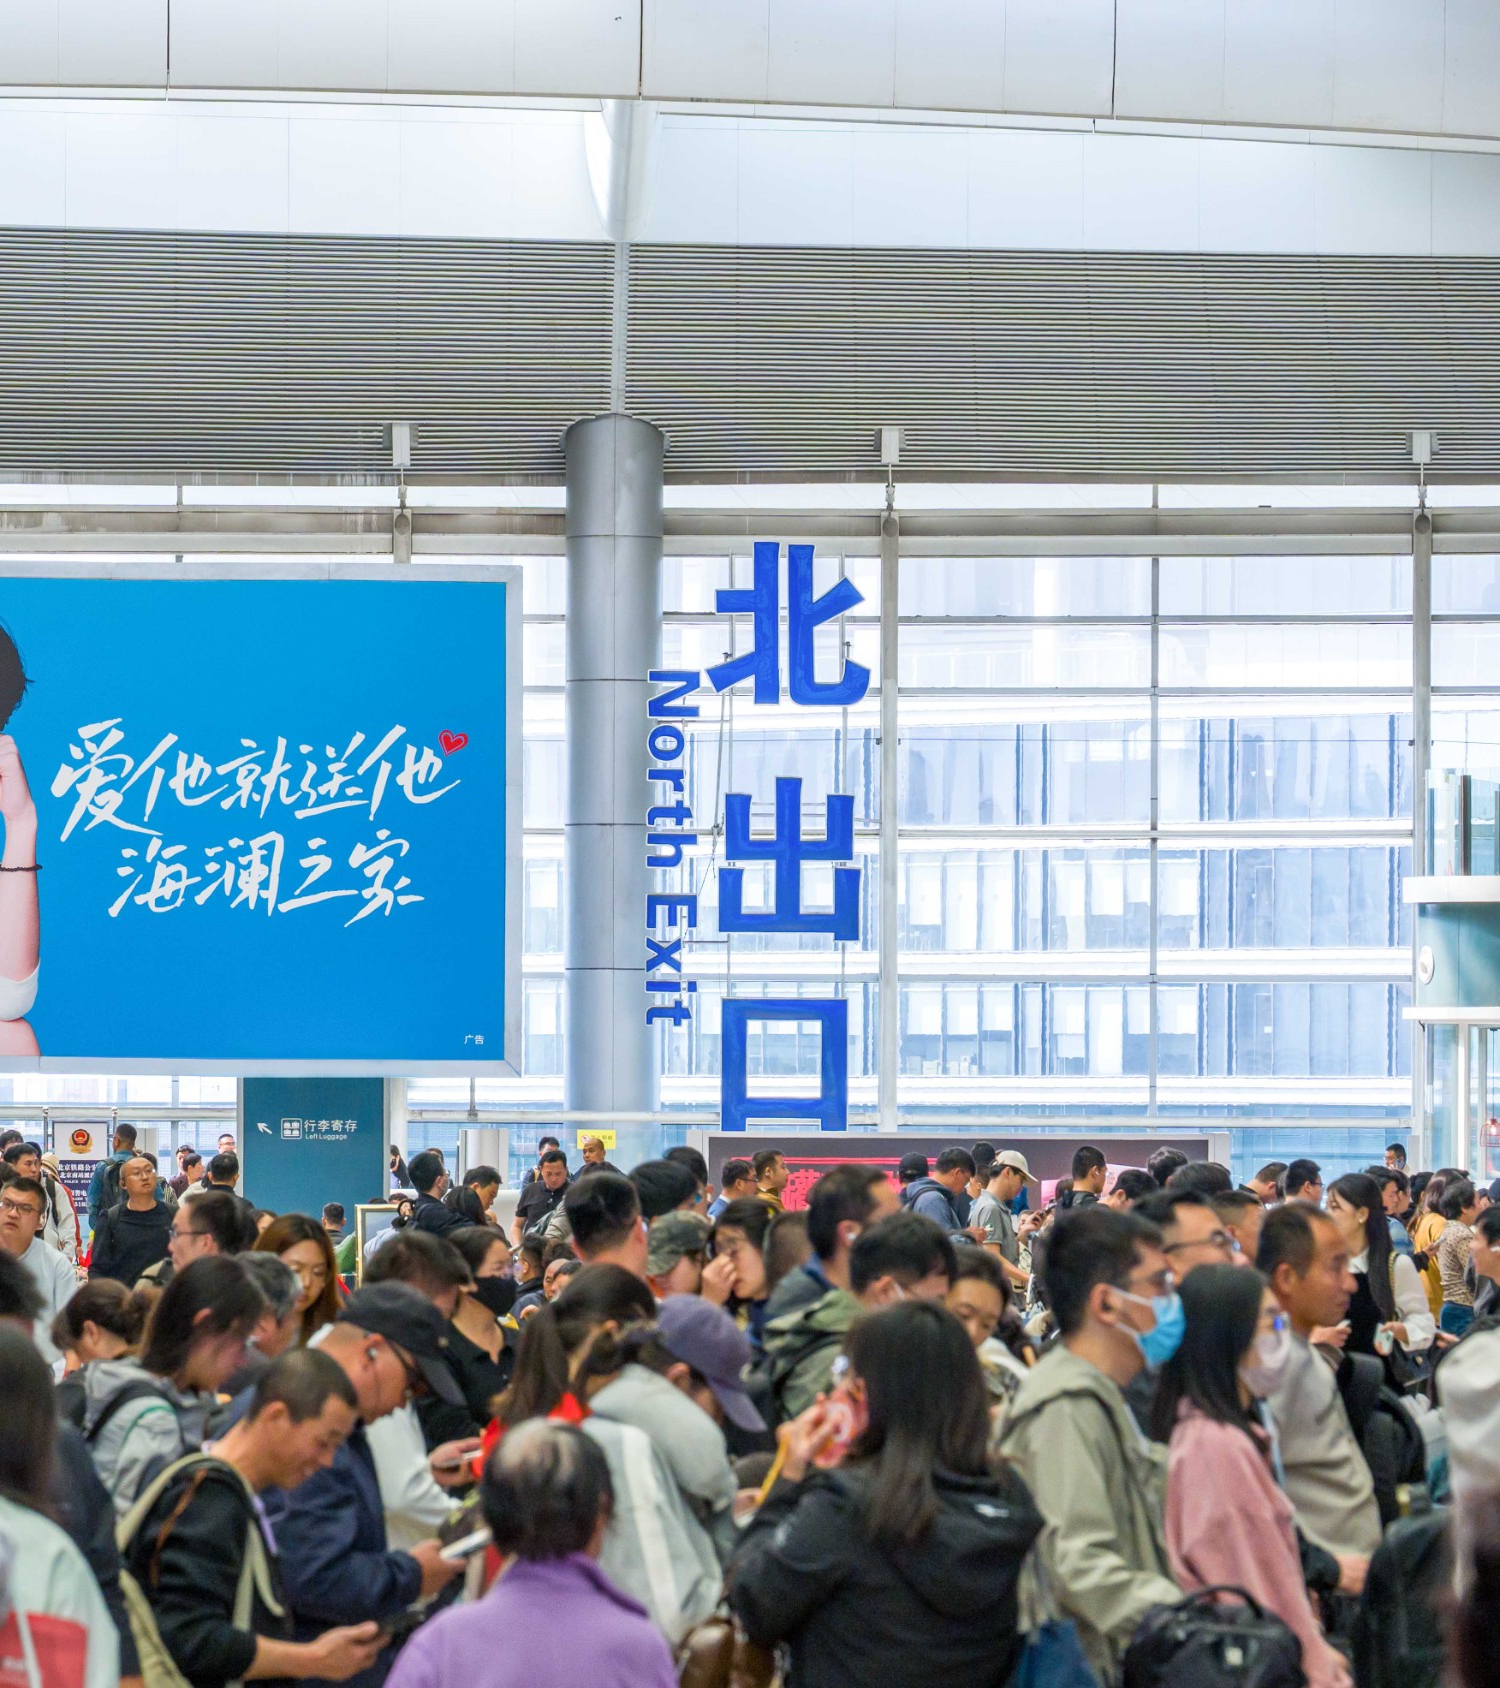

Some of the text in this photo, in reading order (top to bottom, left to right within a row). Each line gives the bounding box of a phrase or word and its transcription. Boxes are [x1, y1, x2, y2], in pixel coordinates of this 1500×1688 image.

[50, 717, 461, 842] 爱他就送他
[108, 829, 425, 928] 海澜之家
[645, 670, 700, 1026] North Exit
[705, 542, 871, 1131] 北出口
[464, 1034, 484, 1045] 广告
[303, 1119, 358, 1133] 行李寄存
[318, 1133, 347, 1141] Luggage
